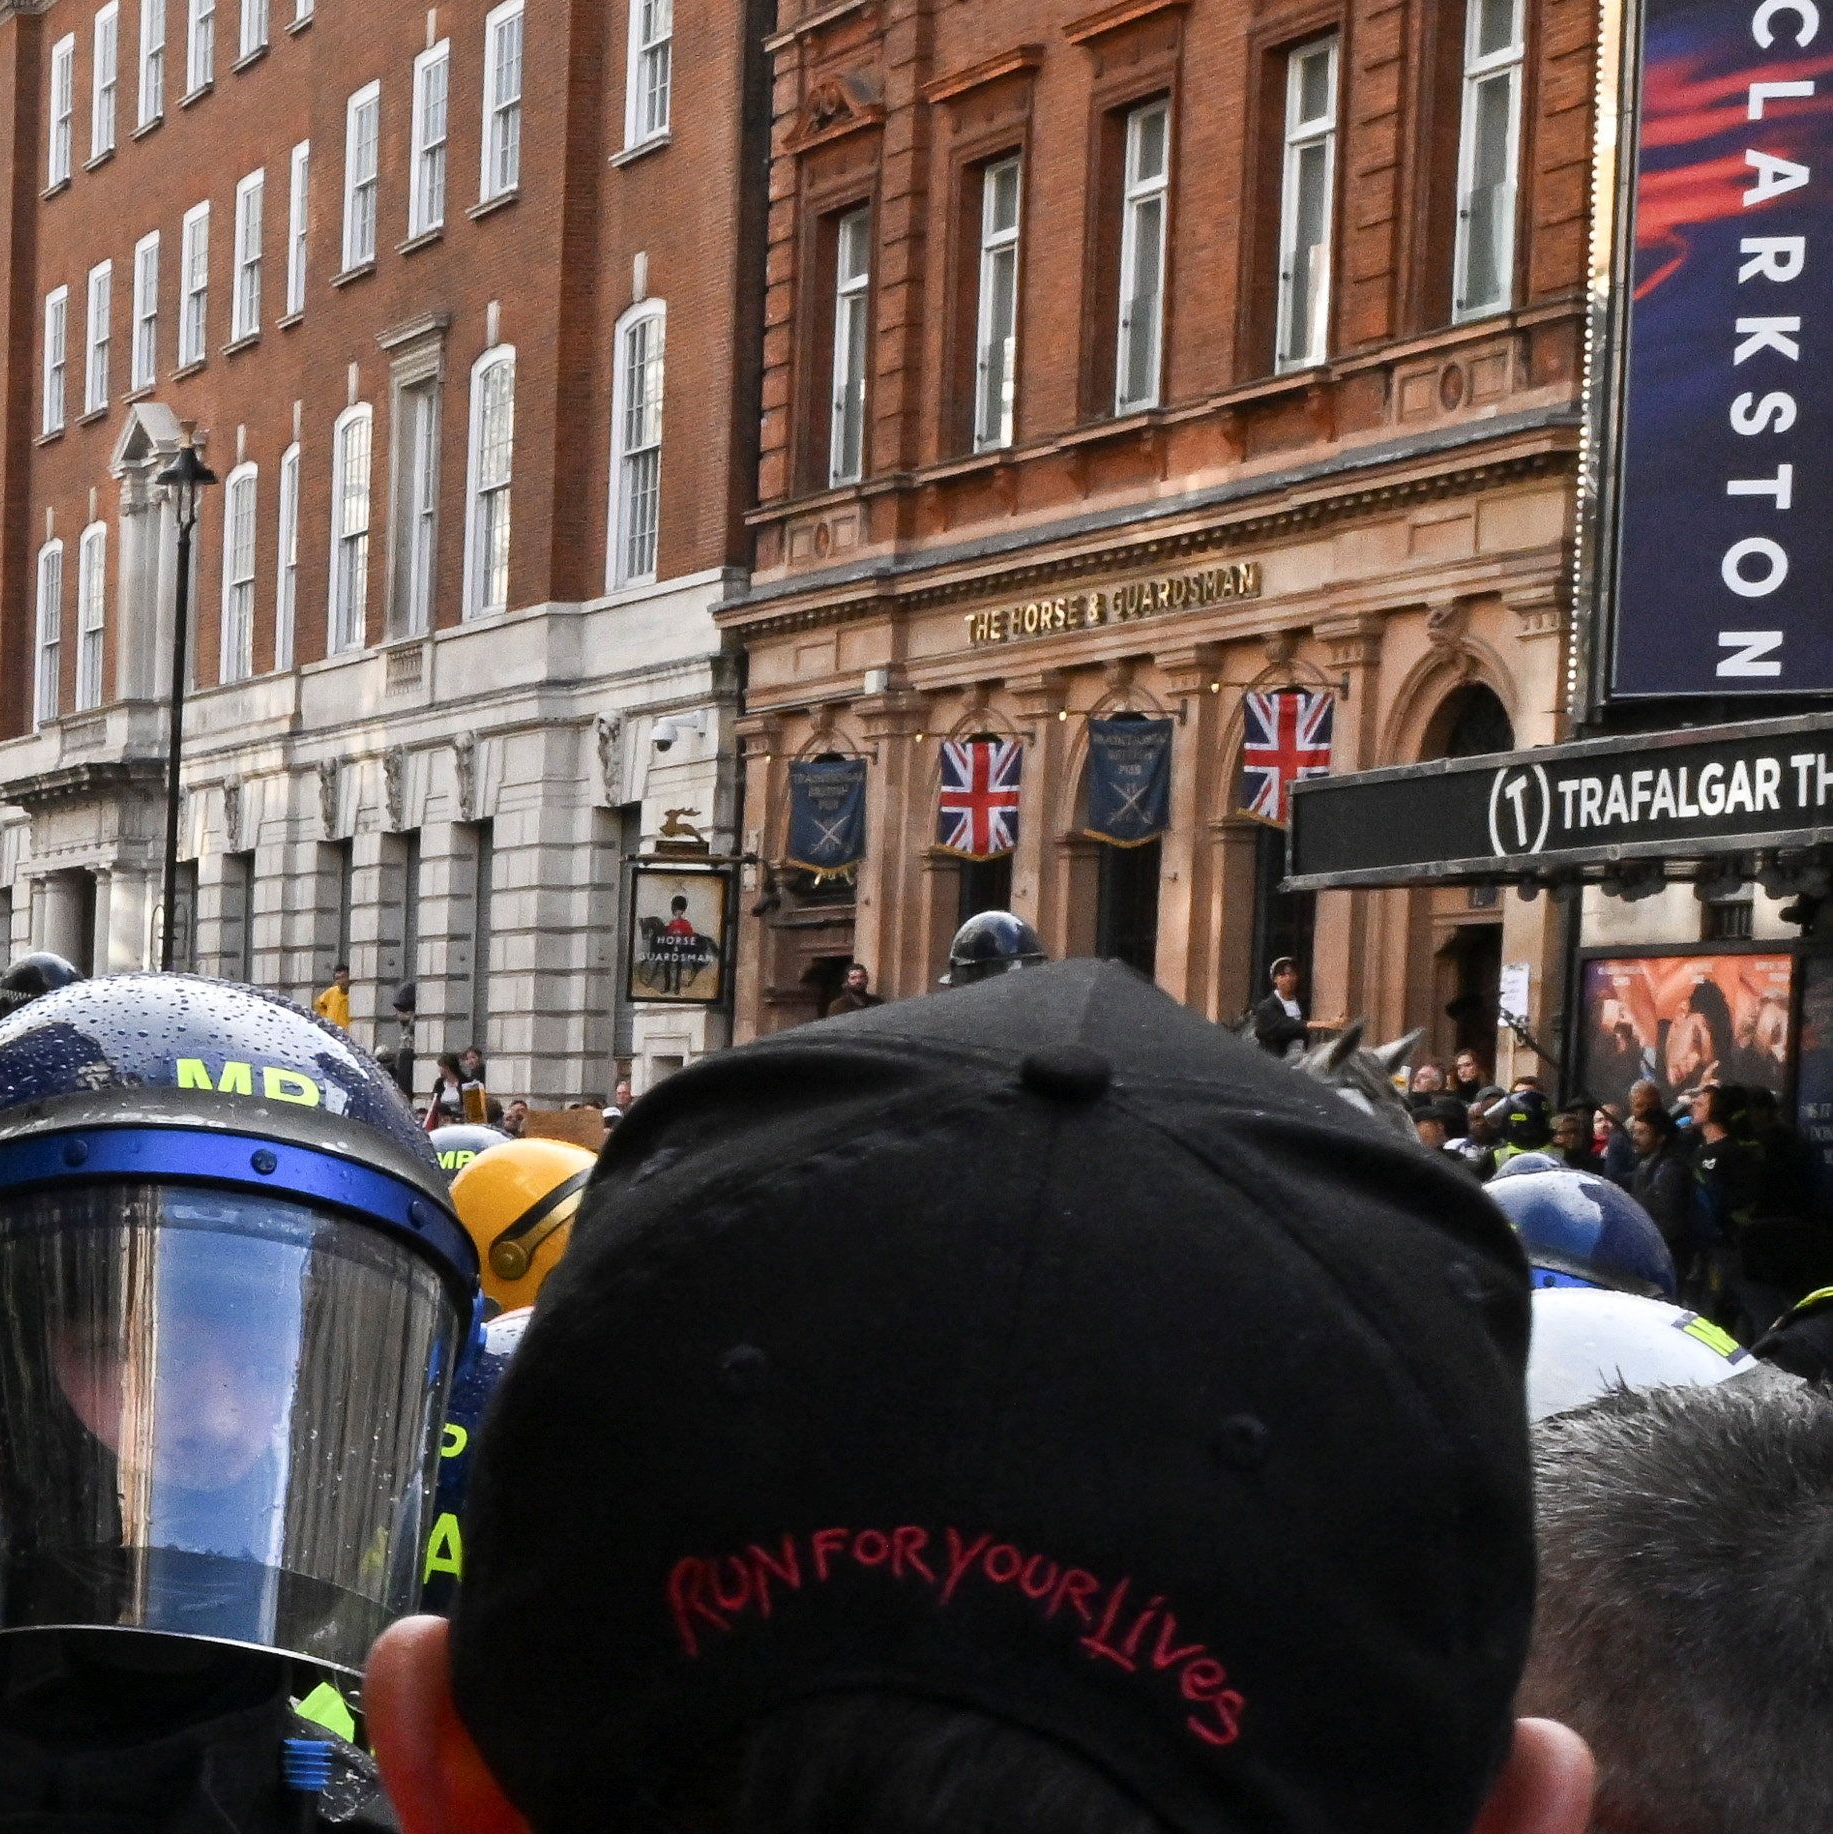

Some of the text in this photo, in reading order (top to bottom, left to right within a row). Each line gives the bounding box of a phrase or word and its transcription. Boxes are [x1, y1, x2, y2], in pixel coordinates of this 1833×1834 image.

[1716, 0, 1819, 678] CLARKSTON
[964, 562, 1259, 644] THE HORSE & GUARDSMAN
[1558, 757, 1781, 829] TRAFALGAR
[1790, 753, 1833, 807] TH
[639, 952, 714, 962] GUARDSMAN
[657, 936, 696, 946] HORSE
[436, 1150, 477, 1170] MP
[664, 1535, 800, 1657] RUN
[813, 1524, 935, 1585] FOR
[943, 1526, 1100, 1622] YOUR
